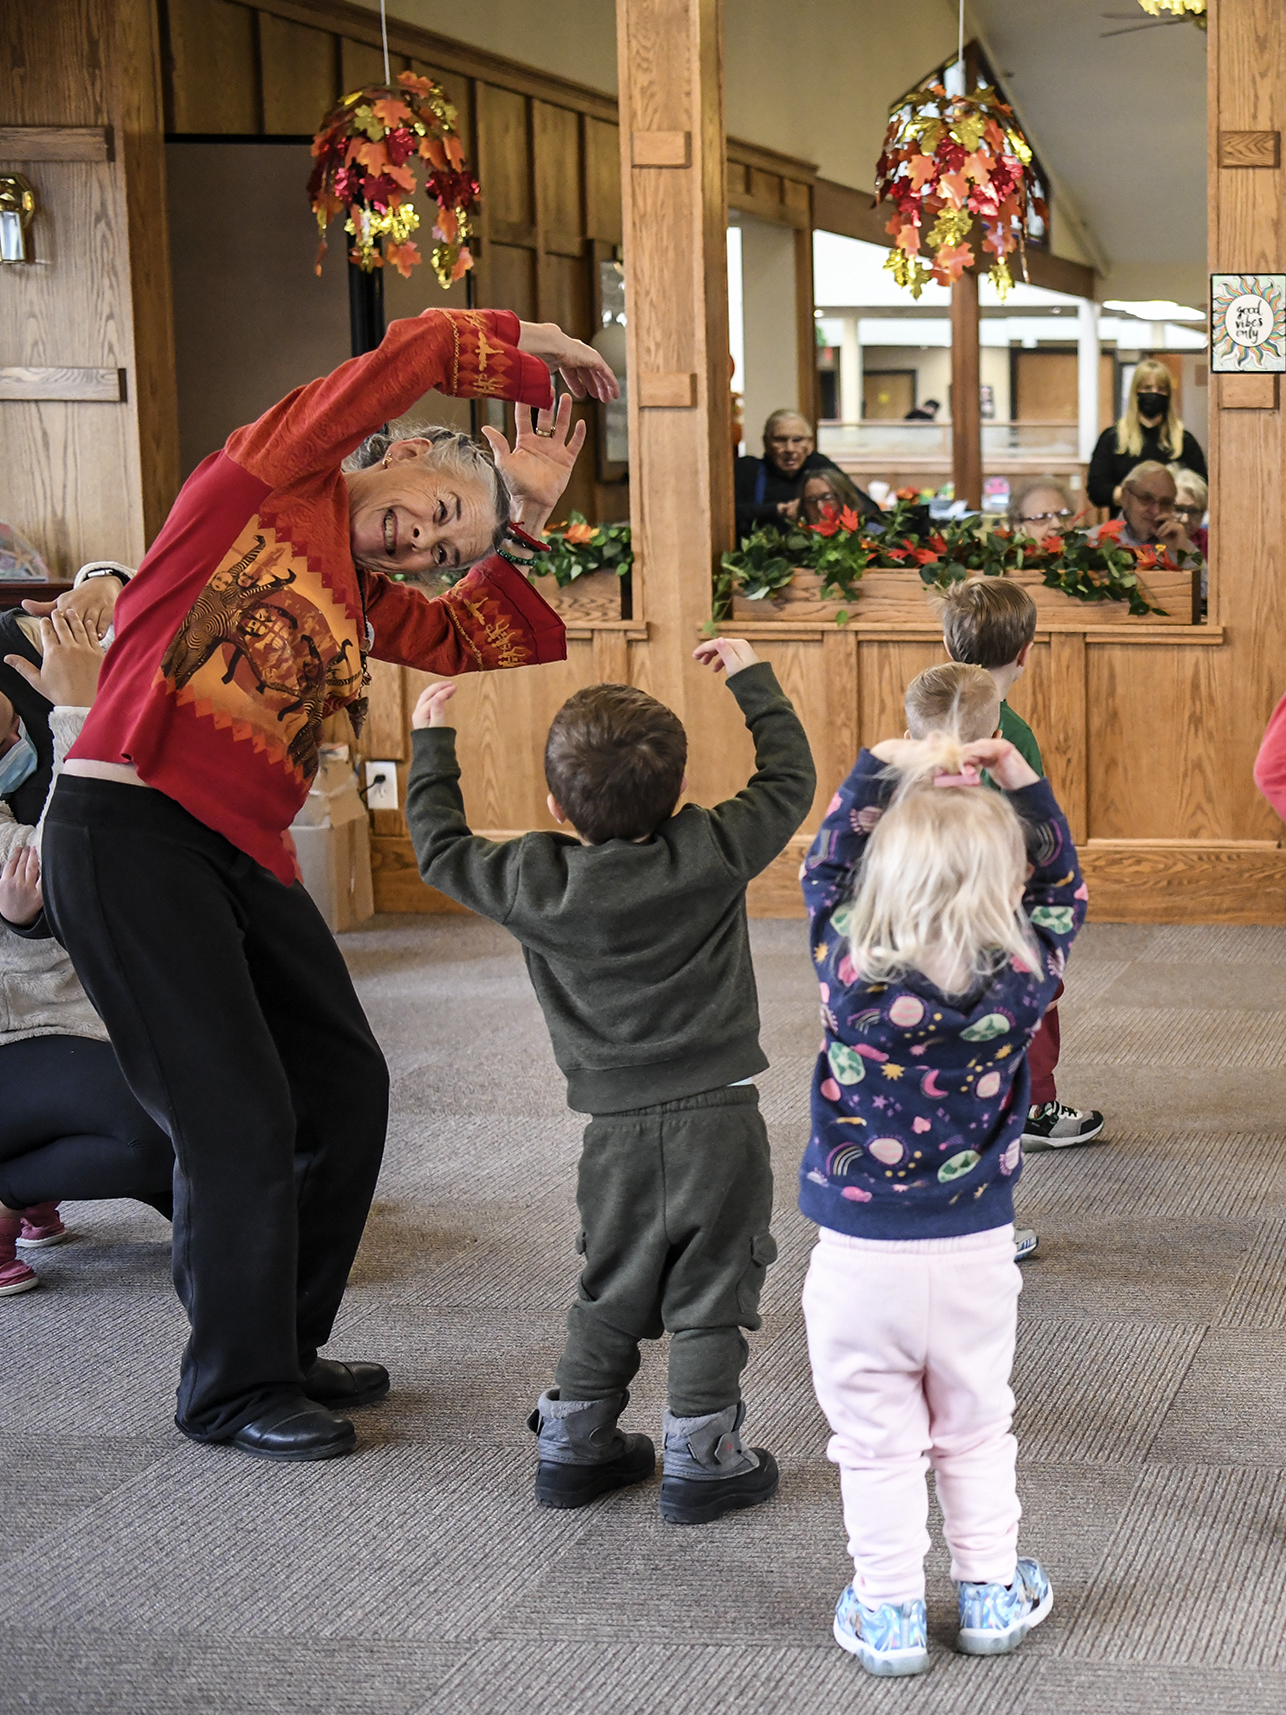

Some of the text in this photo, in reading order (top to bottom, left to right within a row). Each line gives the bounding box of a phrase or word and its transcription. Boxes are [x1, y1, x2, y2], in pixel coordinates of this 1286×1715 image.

[1237, 300, 1262, 320] good
[1235, 316, 1263, 330] vibes
[1236, 327, 1260, 344] only
